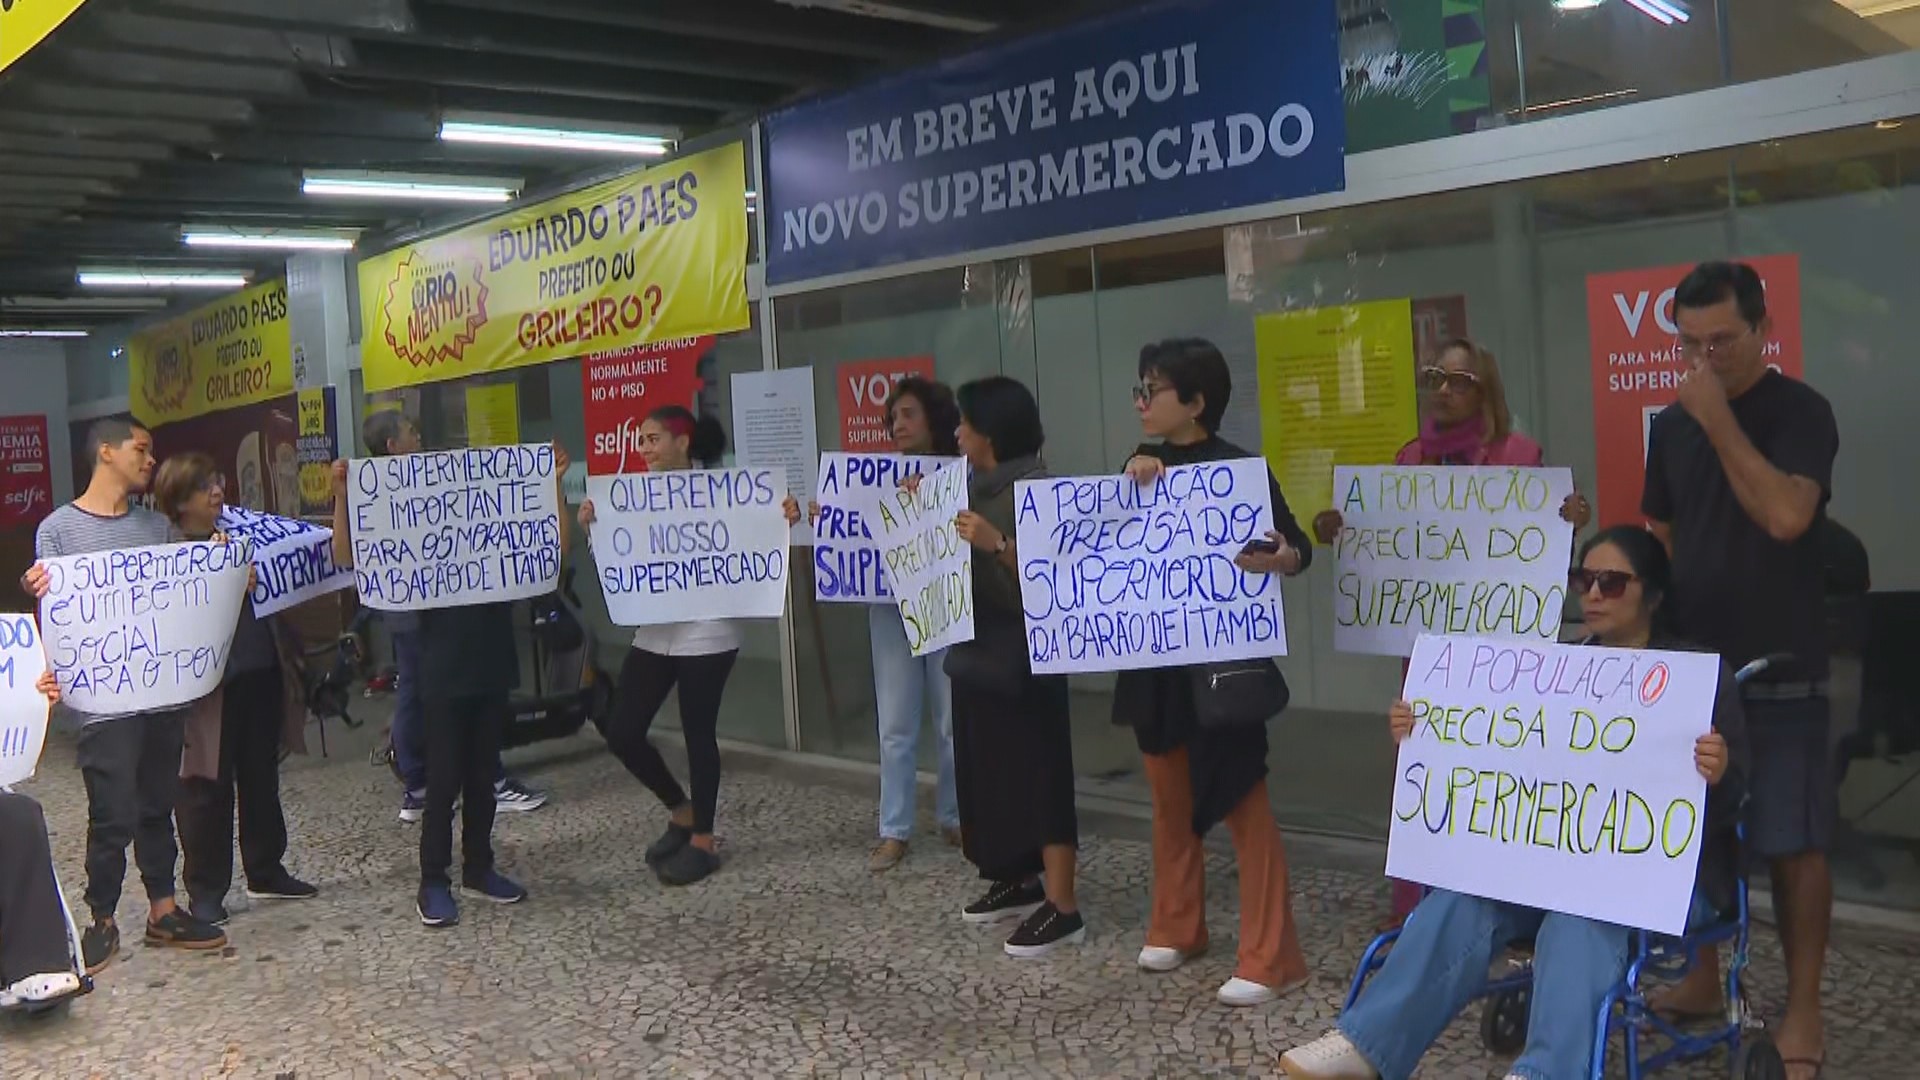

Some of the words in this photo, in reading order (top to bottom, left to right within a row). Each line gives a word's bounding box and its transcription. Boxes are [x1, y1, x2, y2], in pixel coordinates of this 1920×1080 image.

[846, 118, 903, 172] EM
[913, 79, 1056, 156] BREVE
[1070, 42, 1199, 121] AQUI
[782, 190, 887, 252] NOVO
[899, 102, 1314, 229] SUPERMERCADO
[489, 204, 609, 272] EDUARDO
[617, 171, 698, 233] PAES
[539, 260, 605, 300] PREFEITO
[612, 248, 635, 281] OU
[252, 287, 287, 327] PAES
[517, 285, 662, 351] GRILEIRO?
[206, 361, 271, 402] GRILEIRO?
[590, 358, 668, 381] NORMALMENTE
[1609, 352, 1645, 366] PARA
[591, 387, 606, 401] NO
[621, 381, 645, 398] PISO
[0, 434, 41, 449] EMIA
[359, 459, 378, 495] O
[385, 446, 553, 491] SUPERMERCADO
[610, 469, 774, 512] QUEREMOS
[822, 459, 839, 494] A
[1019, 486, 1039, 524] A
[1052, 465, 1233, 521] POPULAÇÃO
[1344, 475, 1364, 512] A
[1379, 469, 1551, 514] POPULAÇÃO
[357, 494, 379, 532] É
[390, 479, 542, 530] IMPORTANTE
[879, 498, 899, 534] A
[1050, 510, 1195, 555] PRECISA
[1197, 503, 1263, 547] DO
[355, 539, 417, 567] PARA
[422, 526, 452, 560] OS
[455, 514, 559, 557] MORADORES
[612, 527, 632, 555] O
[649, 519, 729, 554] NOSSO
[1338, 521, 1470, 561] PRECISA
[1488, 527, 1546, 562] DO
[47, 562, 64, 594] O
[356, 569, 383, 599] DA
[385, 560, 464, 604] BARÃO
[466, 556, 493, 590] DE
[500, 547, 559, 588] ITAMBI
[604, 549, 782, 594] SUPERMERCADO
[1337, 573, 1565, 638] SUPERMERCADO
[53, 617, 172, 668] SOCIAL
[1029, 626, 1060, 662] DA
[1062, 611, 1145, 660] BARÃO
[1146, 609, 1181, 654] DE
[54, 664, 134, 696] PARA
[142, 659, 161, 688] O
[174, 632, 233, 685] POV
[1424, 642, 1451, 689] A
[1468, 645, 1670, 707] POPULAÇÃO
[1409, 700, 1547, 749] PRECISA
[1569, 707, 1636, 754] DO
[1396, 762, 1697, 859] SUPERMERCADO
